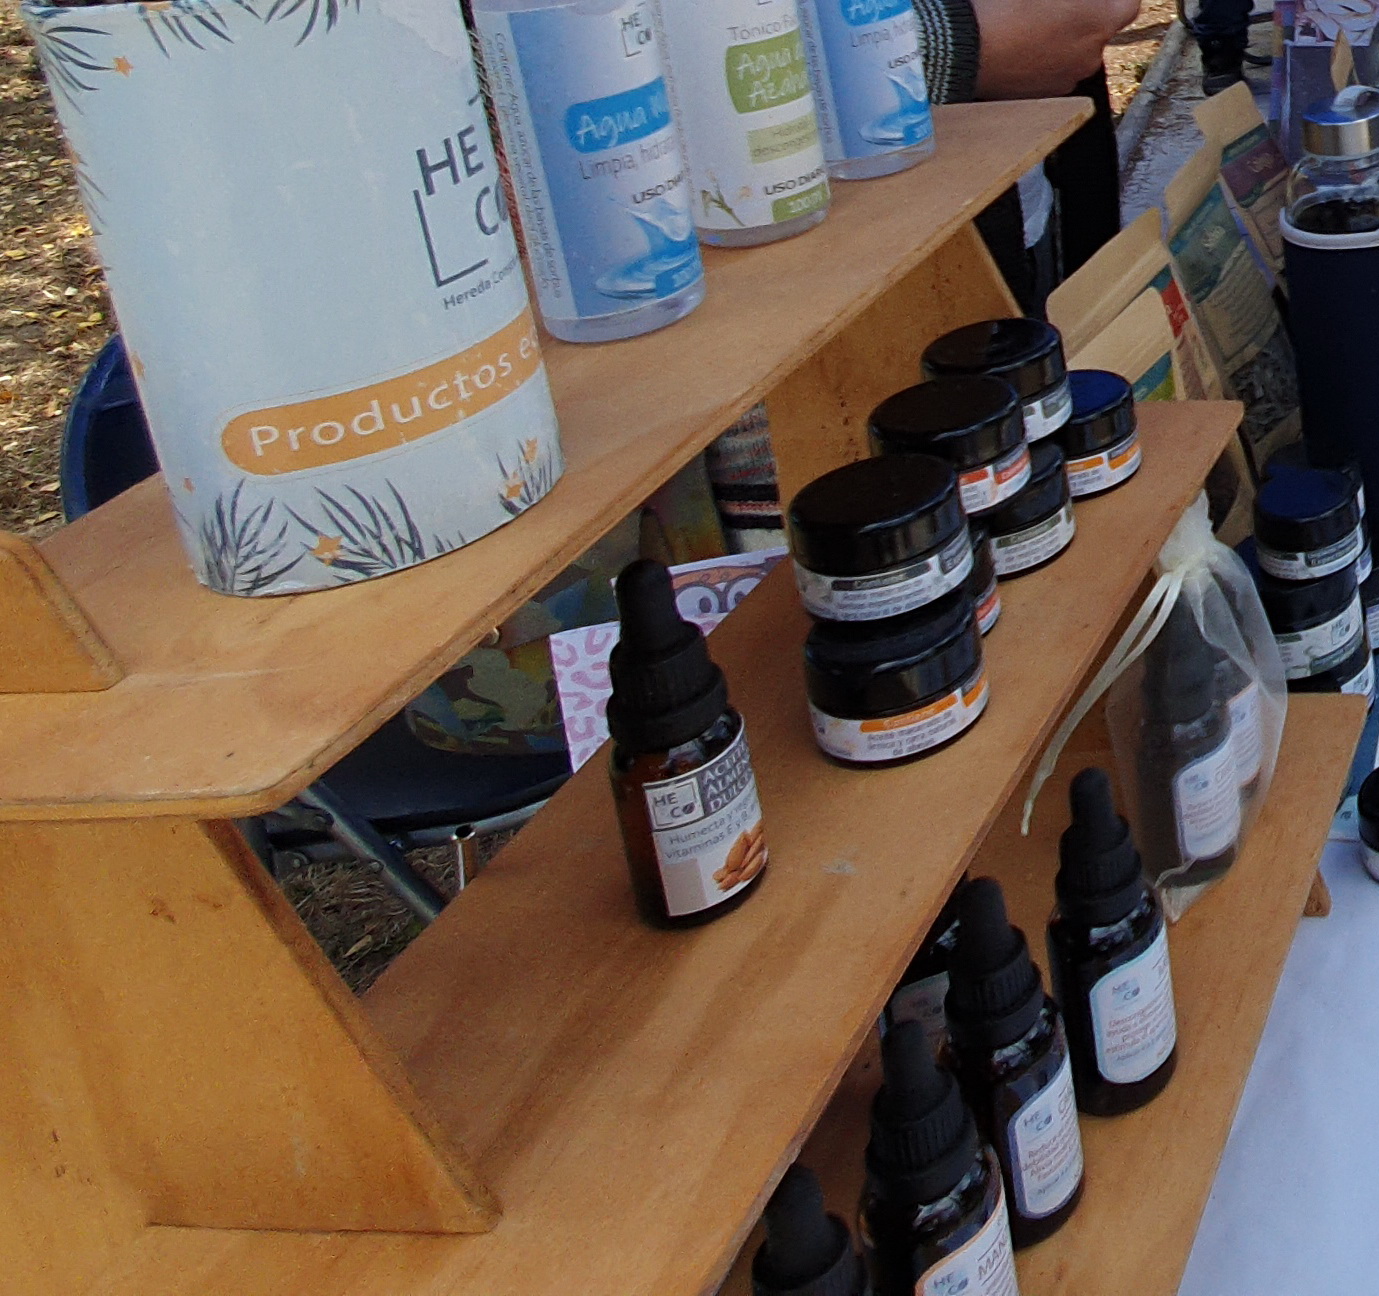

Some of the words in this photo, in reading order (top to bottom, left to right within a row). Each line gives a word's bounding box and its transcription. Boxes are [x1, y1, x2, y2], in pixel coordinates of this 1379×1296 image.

[620, 12, 642, 32] HE
[737, 52, 791, 81] Agua
[577, 105, 648, 147] Agua
[416, 123, 484, 195] HE
[764, 178, 796, 196] USO
[443, 278, 493, 310] Hereda
[249, 351, 513, 457] Productos
[653, 792, 678, 806] HE
[669, 816, 727, 845] Humecta
[666, 832, 725, 859] vitaminas
